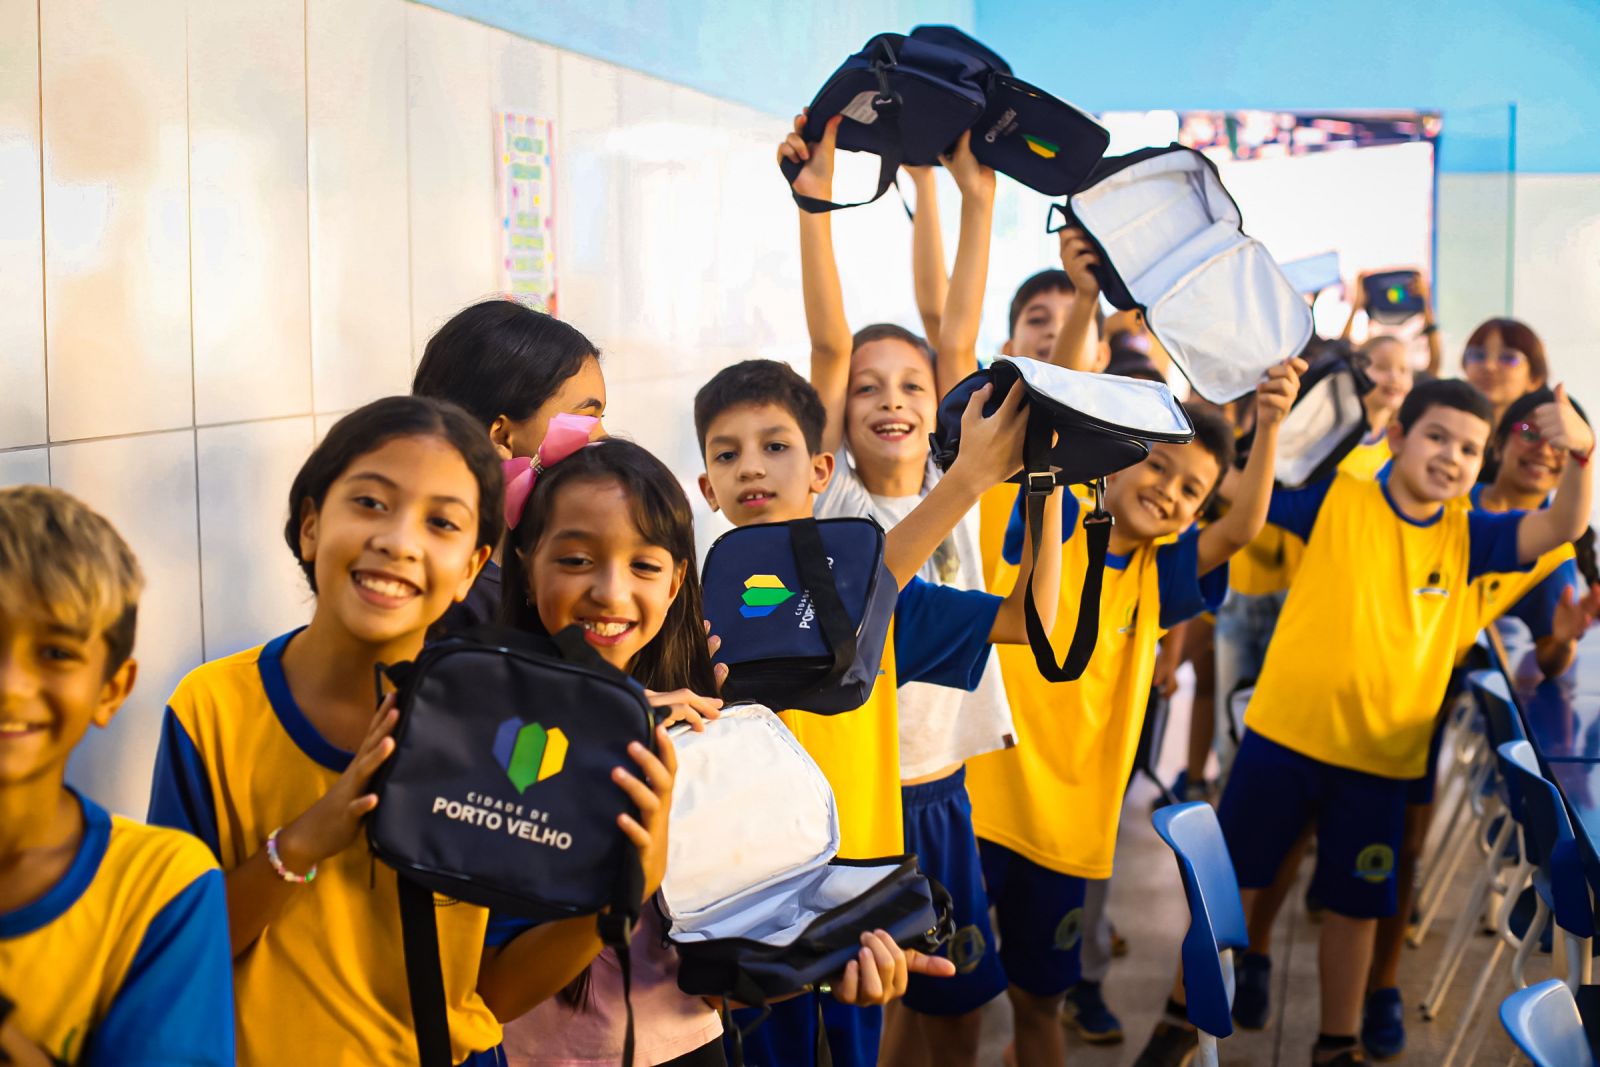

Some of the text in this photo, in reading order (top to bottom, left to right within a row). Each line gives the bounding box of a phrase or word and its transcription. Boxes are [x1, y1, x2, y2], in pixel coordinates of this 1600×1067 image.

[432, 796, 573, 850] PORTO VELHO
[466, 791, 549, 823] CIDADE DE
